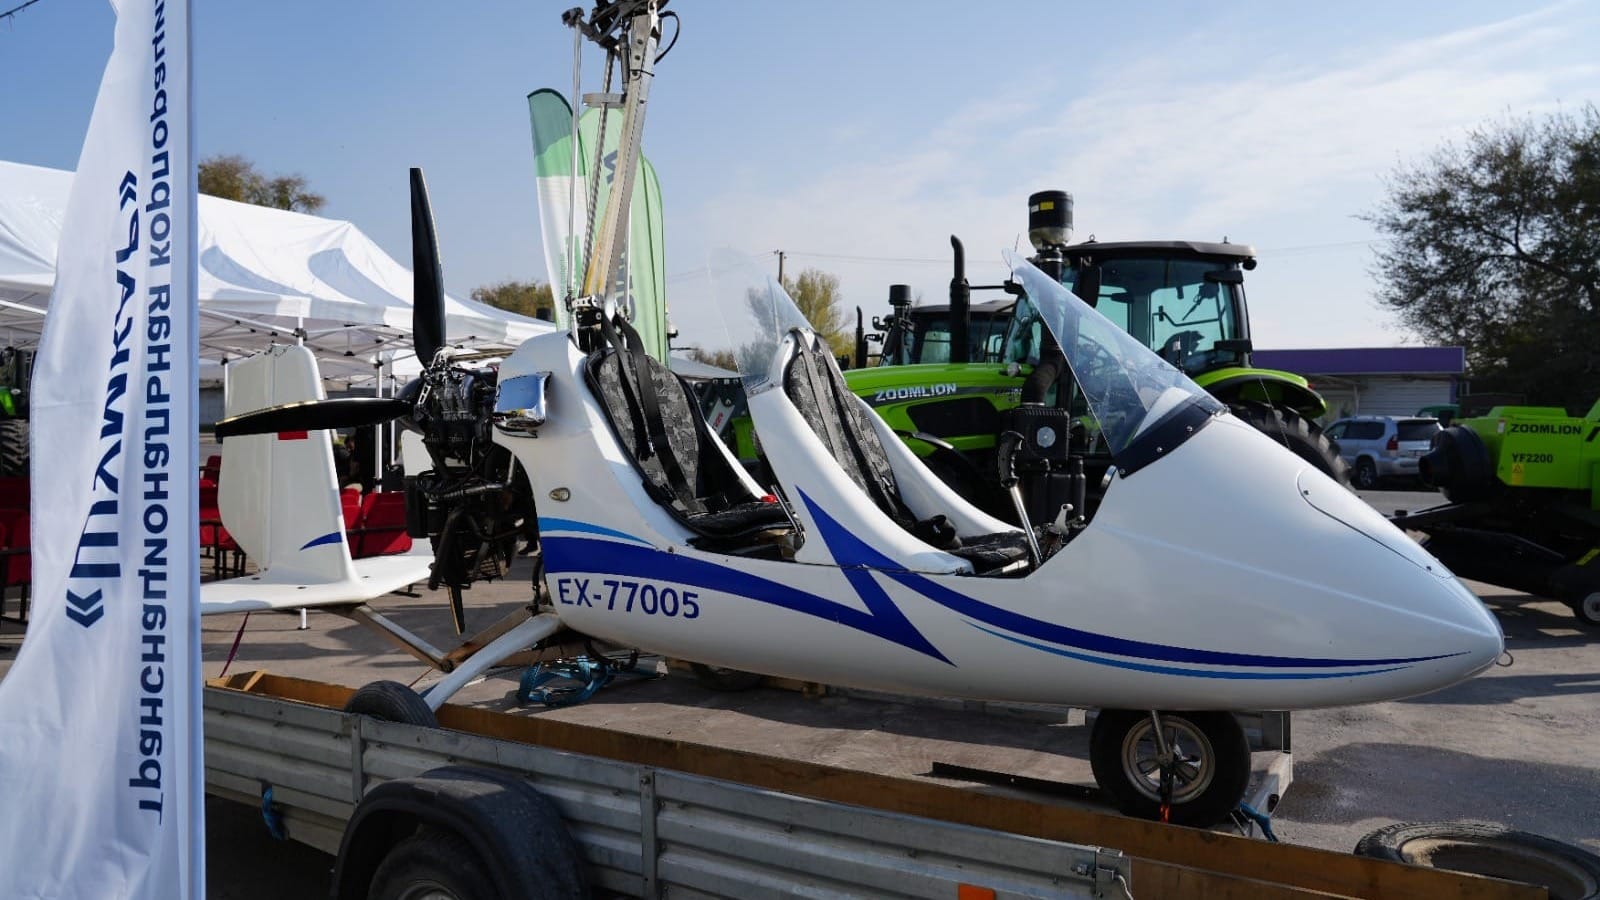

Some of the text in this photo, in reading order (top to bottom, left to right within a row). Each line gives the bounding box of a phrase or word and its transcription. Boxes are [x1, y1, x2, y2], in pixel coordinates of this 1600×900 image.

[875, 383, 957, 402] ZOOMLION
[1510, 424, 1582, 435] ZOOMLION
[1512, 453, 1553, 463] YF2200
[558, 578, 700, 619] EX-77005
